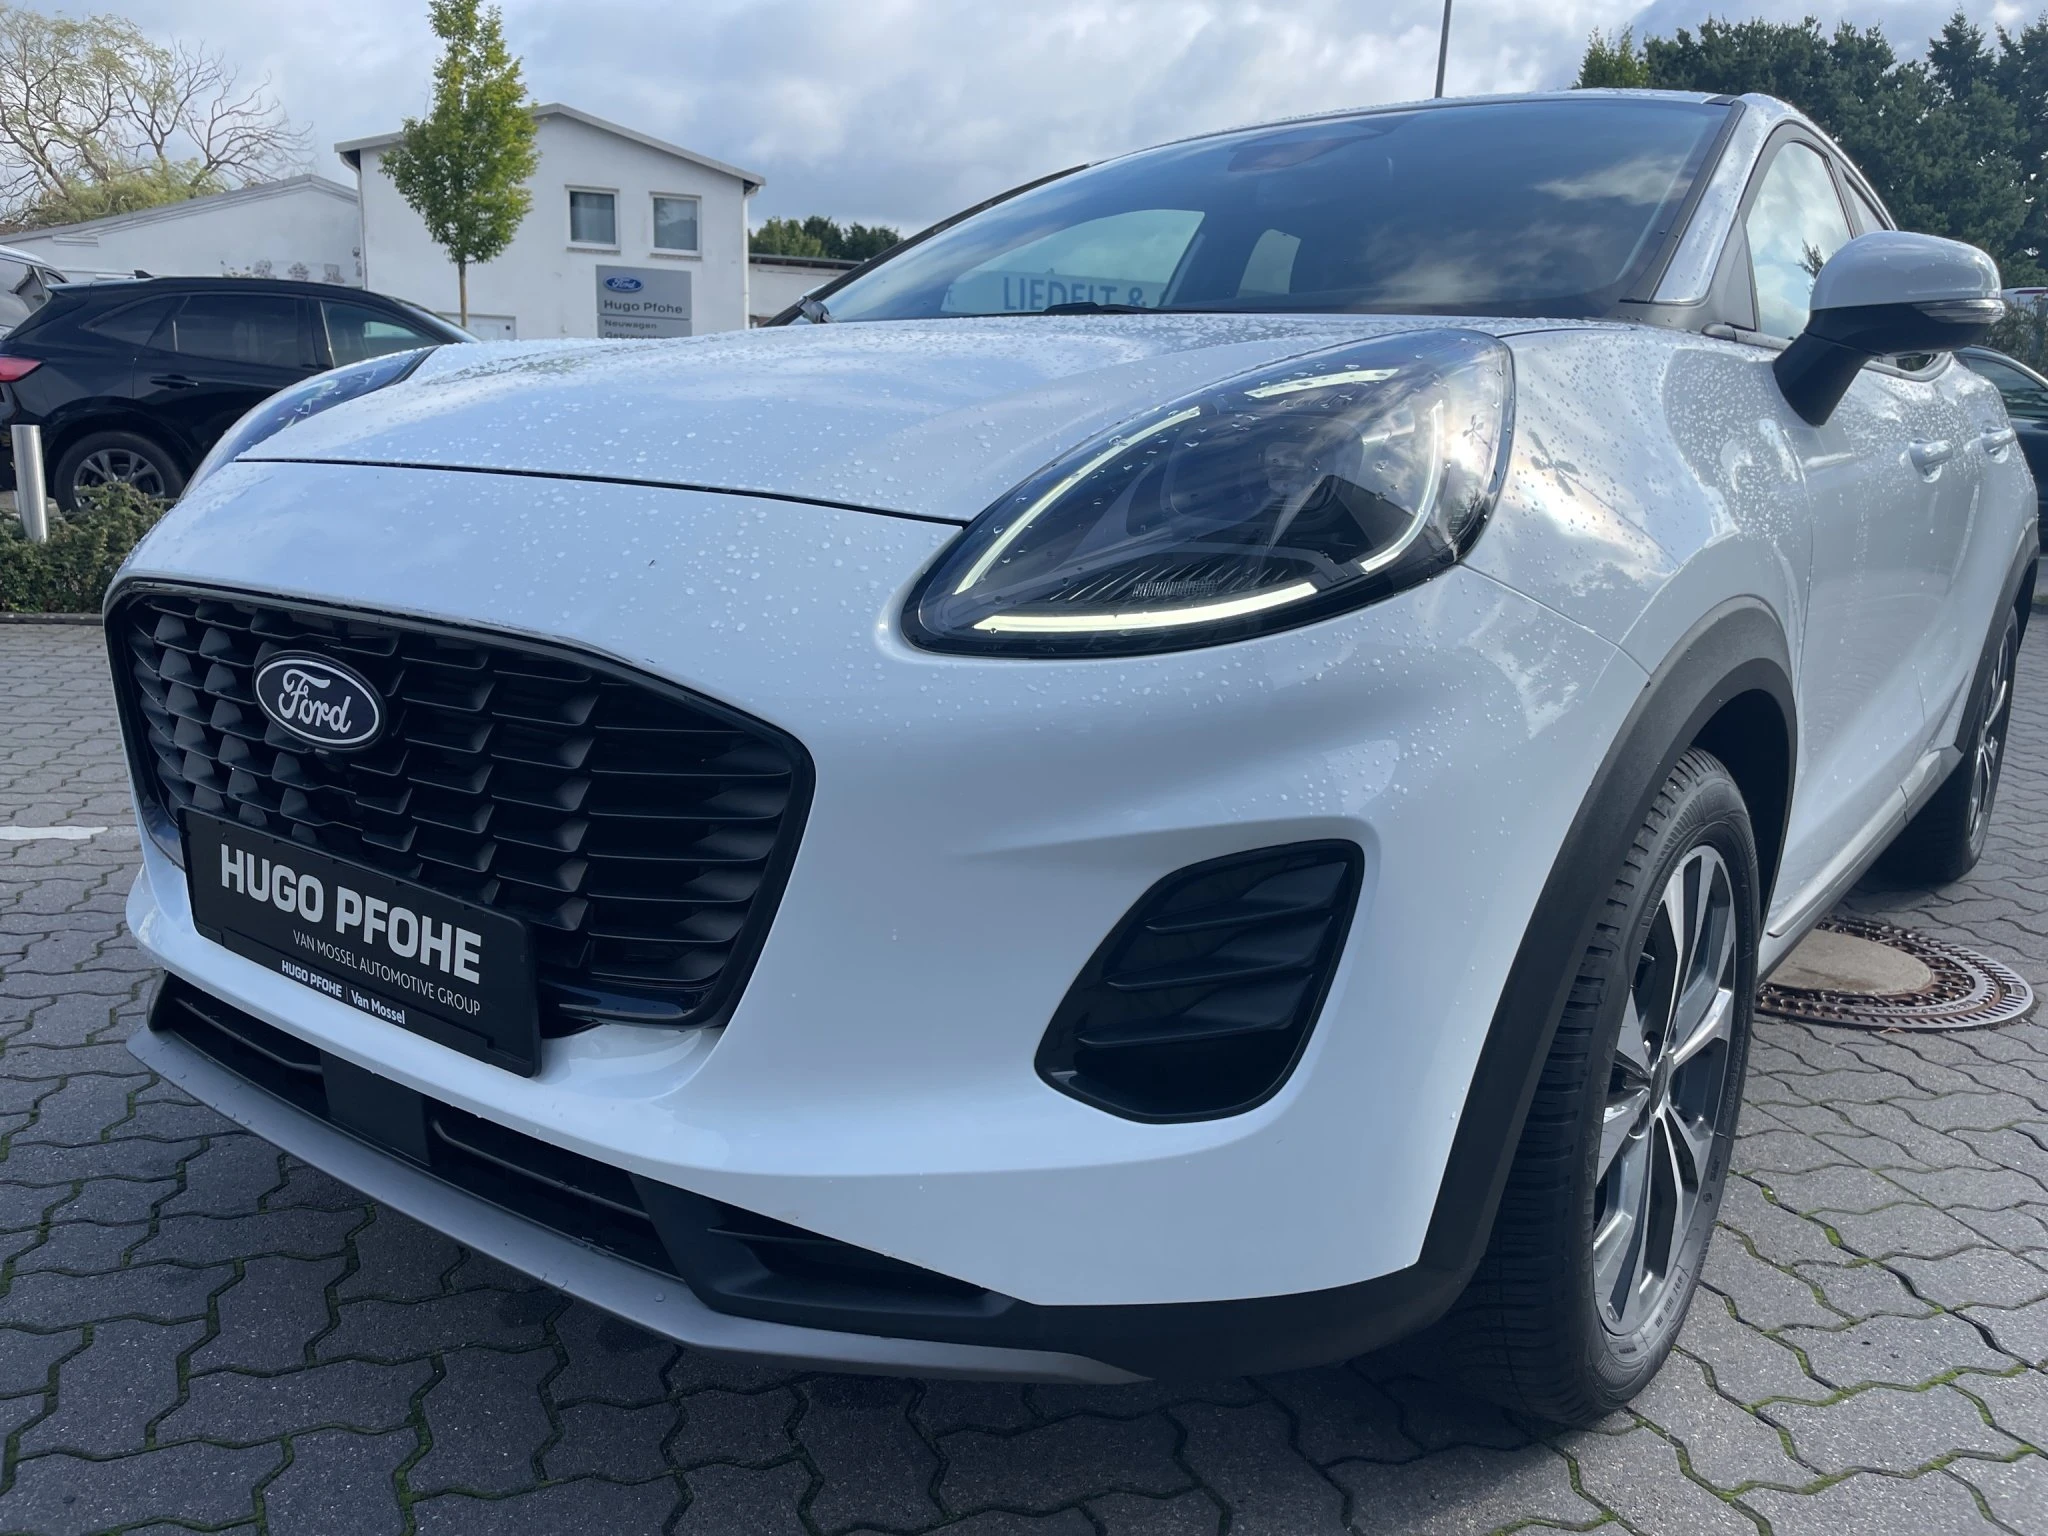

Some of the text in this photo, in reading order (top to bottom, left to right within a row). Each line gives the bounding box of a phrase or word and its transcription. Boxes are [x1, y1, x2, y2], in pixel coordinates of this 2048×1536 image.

[604, 300, 683, 314] Hugo Pfohe
[604, 319, 657, 330] Neuwagen
[1128, 286, 1147, 307] &
[278, 668, 352, 734] Ford
[220, 843, 482, 985] HUGO PFOHE
[281, 959, 406, 1025] HUGO PFOHE Van Mossel
[293, 929, 481, 1016] VAN MOSSEL AUTOMOTIVE GROUP
